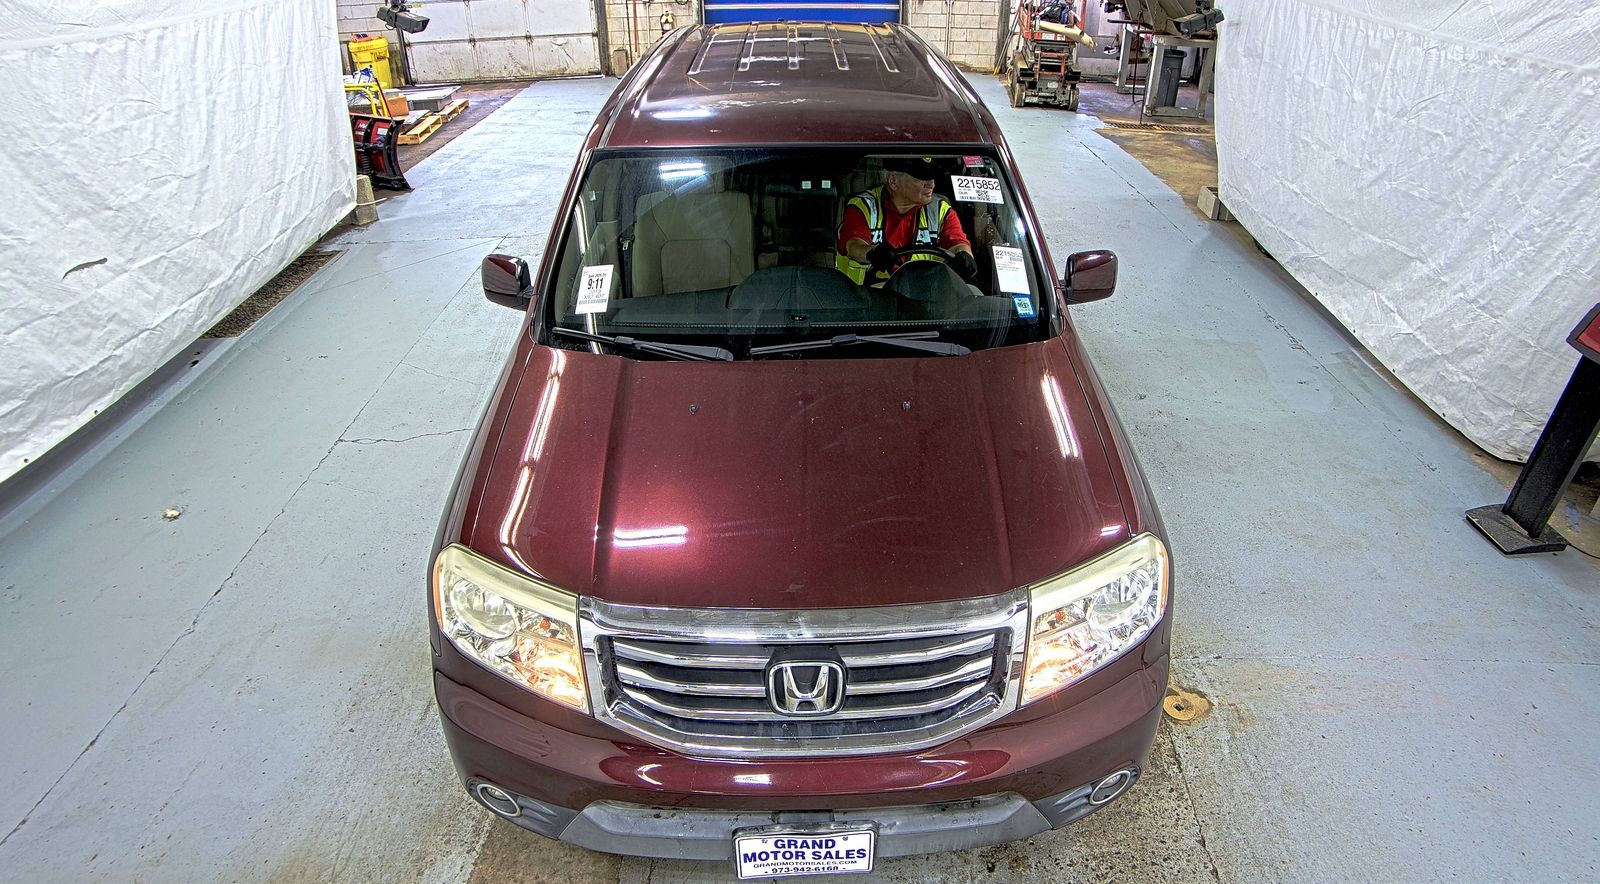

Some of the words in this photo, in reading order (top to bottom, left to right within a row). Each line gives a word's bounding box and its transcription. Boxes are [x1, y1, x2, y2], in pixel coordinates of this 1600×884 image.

[957, 178, 1001, 190] 2215852
[587, 277, 604, 290] 9:11
[774, 838, 836, 849] GRAND
[743, 850, 806, 863] MOTOR
[811, 848, 867, 861] SALES
[753, 860, 857, 868] GRANDMOTORSALES.COM
